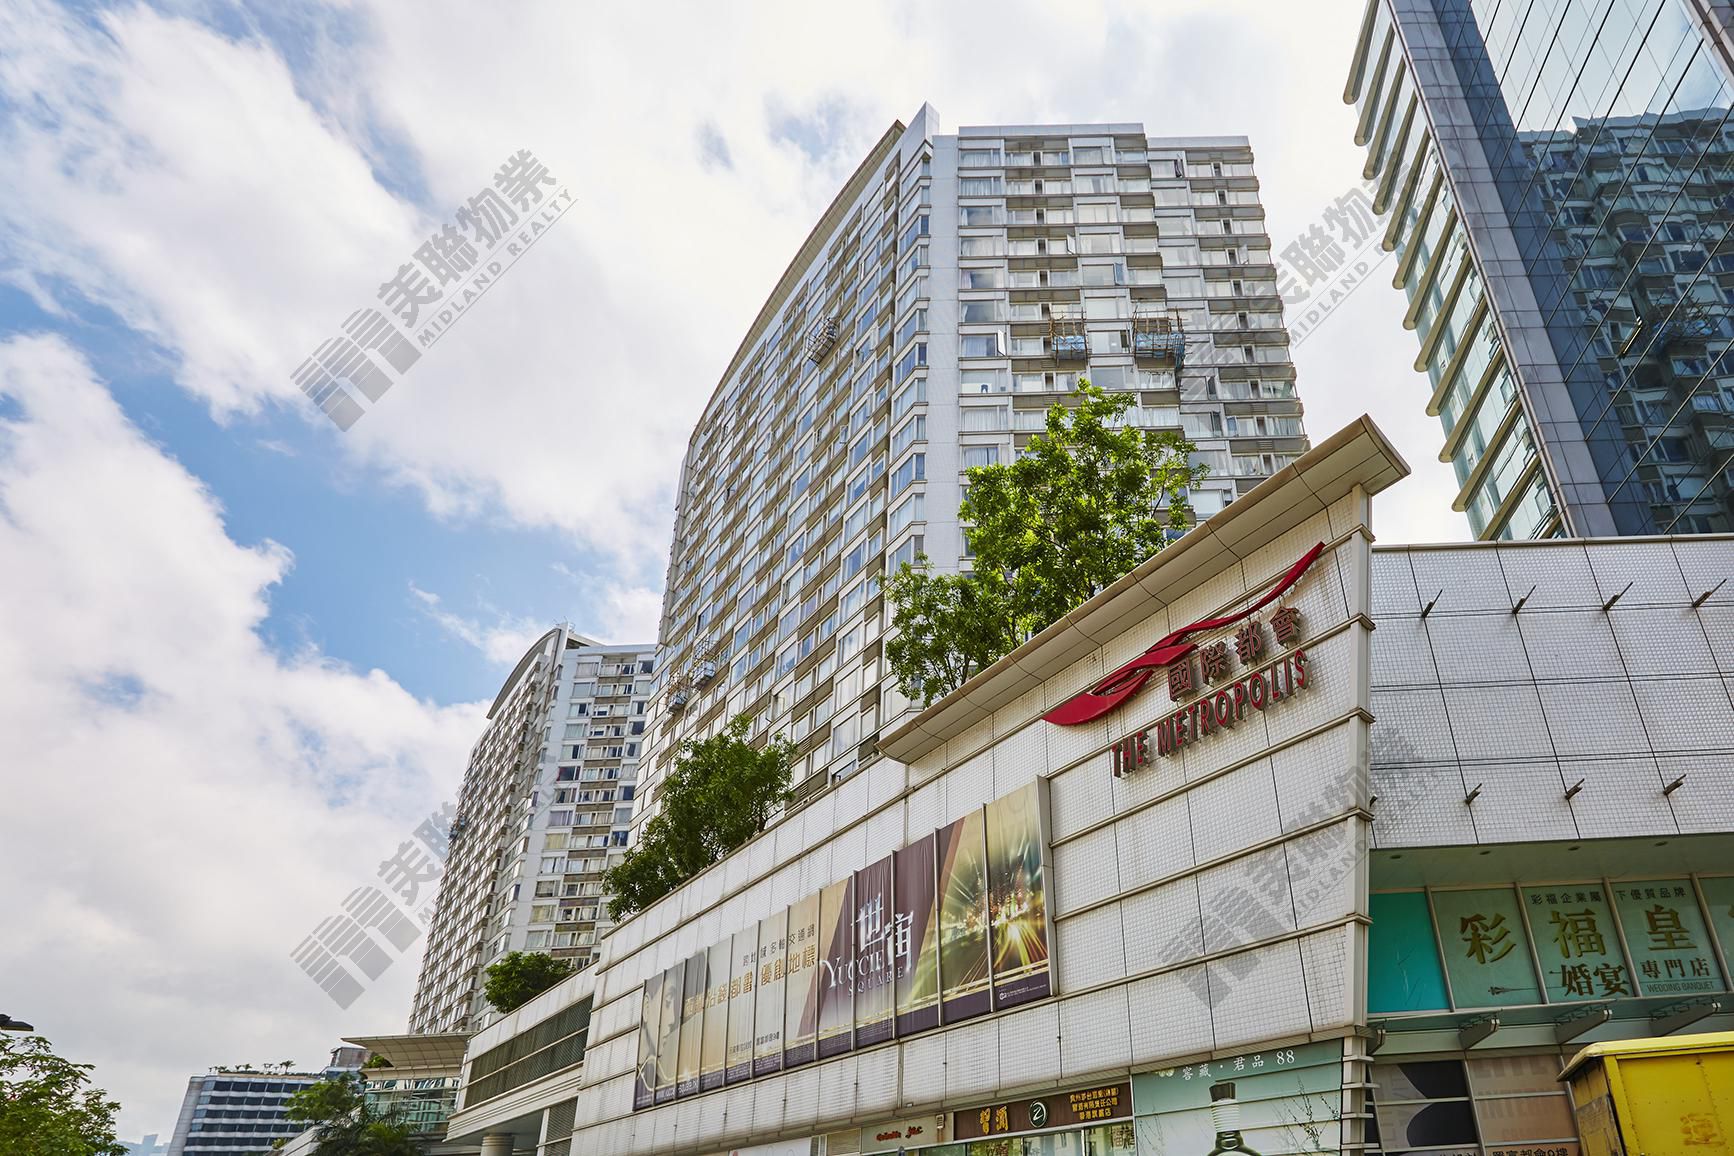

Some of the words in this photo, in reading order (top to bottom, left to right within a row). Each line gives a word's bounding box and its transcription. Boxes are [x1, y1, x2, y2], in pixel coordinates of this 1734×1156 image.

[1168, 606, 1302, 701] 國際都會
[1111, 730, 1149, 778] THE
[1157, 649, 1310, 757] METROPOLIS
[851, 892, 915, 973] 世宙
[848, 966, 905, 997] SQUARE
[1640, 957, 1711, 979] 專門店
[1646, 982, 1681, 993] WEDDING
[1682, 980, 1714, 991] BANQUET
[1276, 1049, 1295, 1066] 88
